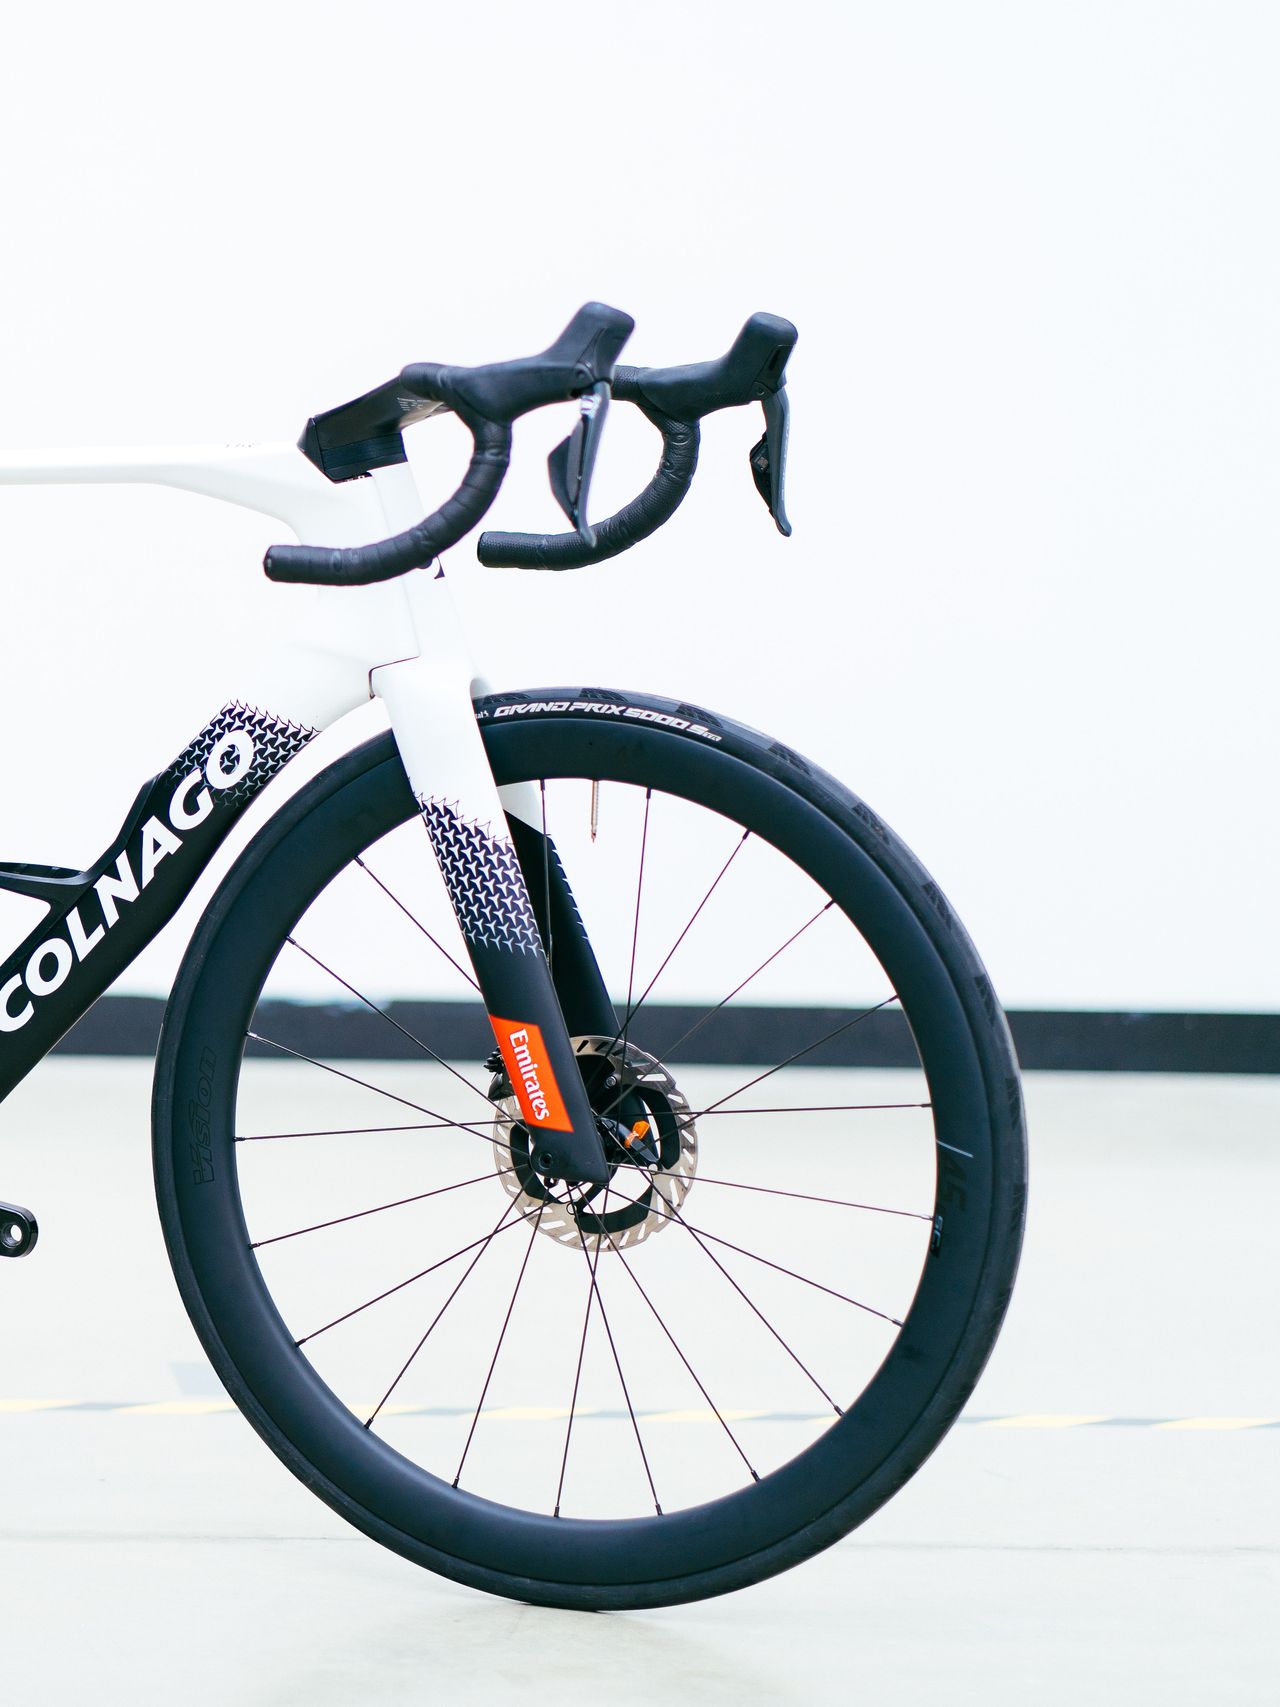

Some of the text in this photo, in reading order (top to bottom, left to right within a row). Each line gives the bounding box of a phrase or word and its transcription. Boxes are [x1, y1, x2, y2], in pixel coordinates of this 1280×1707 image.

[493, 702, 570, 718] GRAND
[569, 702, 626, 717] PRIX
[622, 708, 691, 730] 5000
[509, 1028, 550, 1121] Emirates
